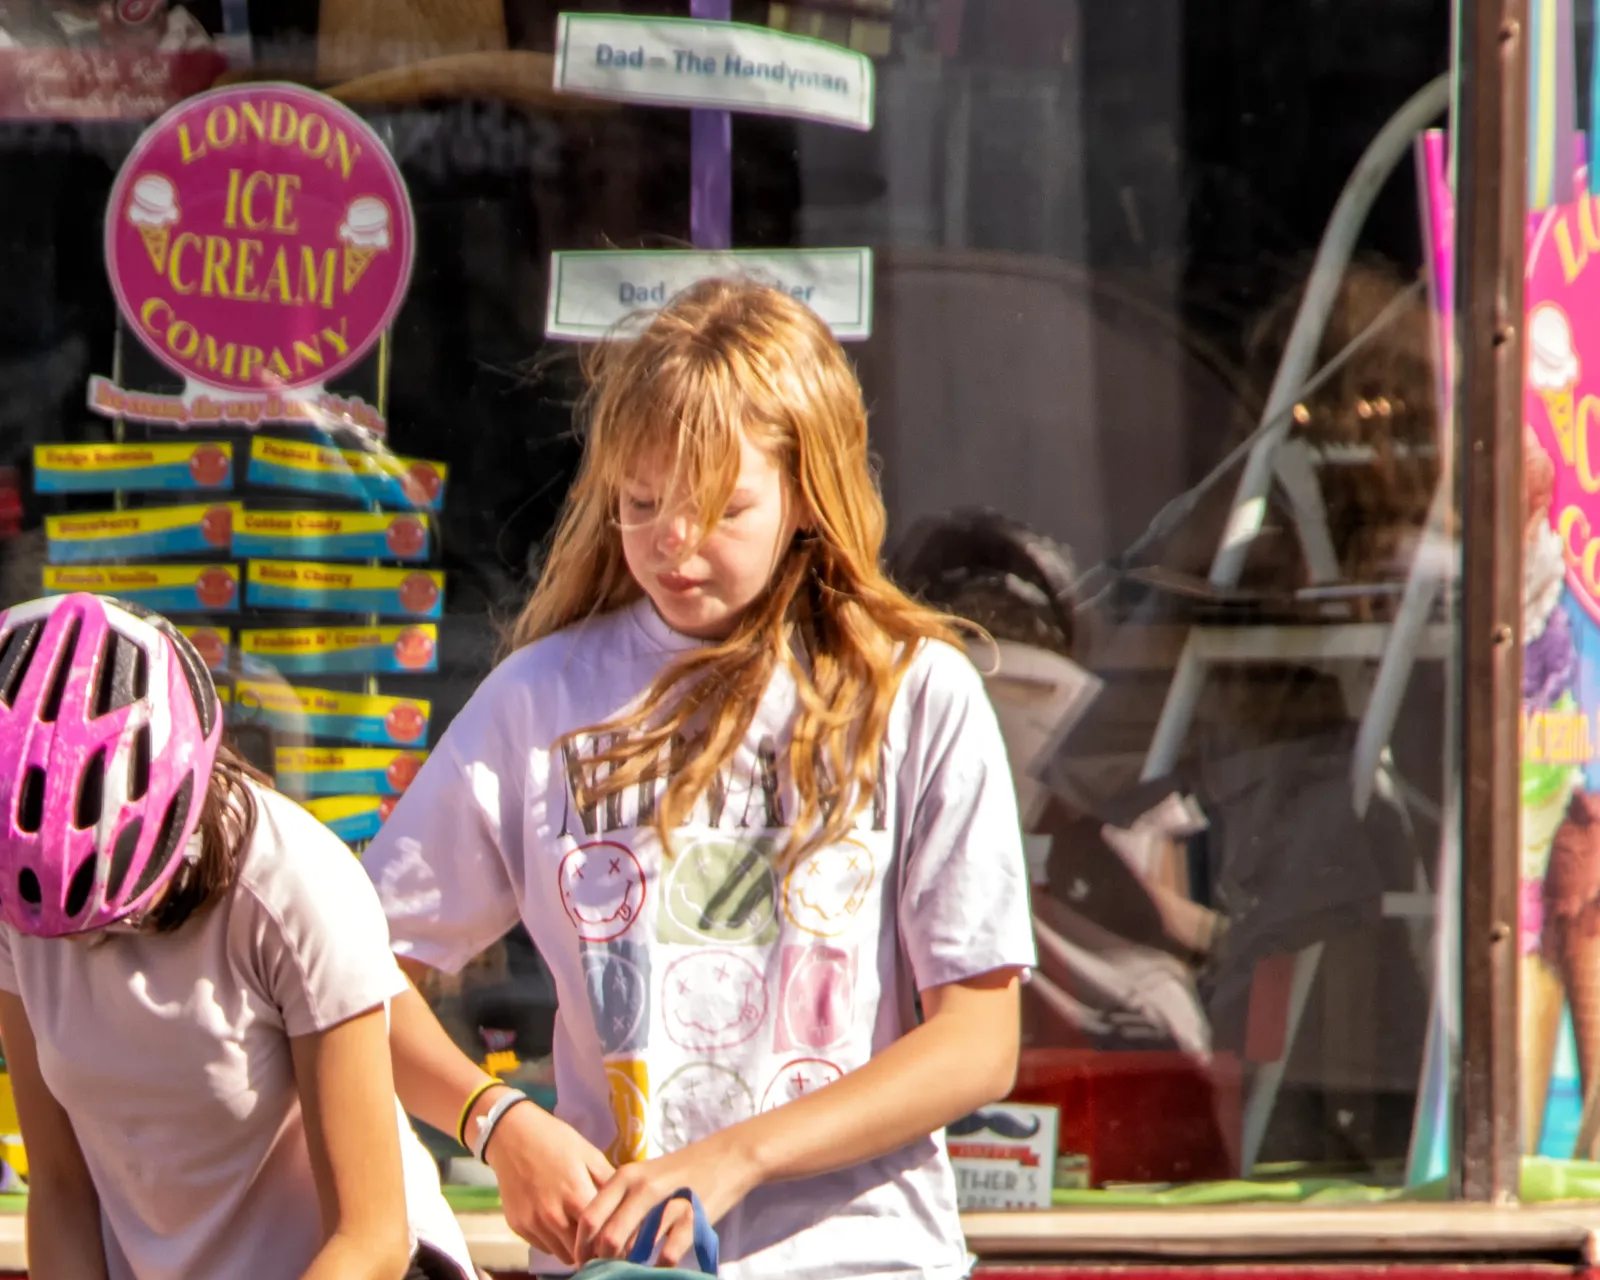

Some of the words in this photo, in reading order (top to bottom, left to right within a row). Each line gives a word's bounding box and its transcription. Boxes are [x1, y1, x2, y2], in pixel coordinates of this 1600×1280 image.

[595, 43, 644, 71] Dad
[673, 49, 717, 75] The
[723, 54, 850, 95] Handyman
[177, 100, 362, 181] LONDON
[223, 168, 302, 235] ICE
[168, 231, 338, 309] CREAM
[618, 280, 666, 306] Dad
[140, 296, 349, 382] COMPANY
